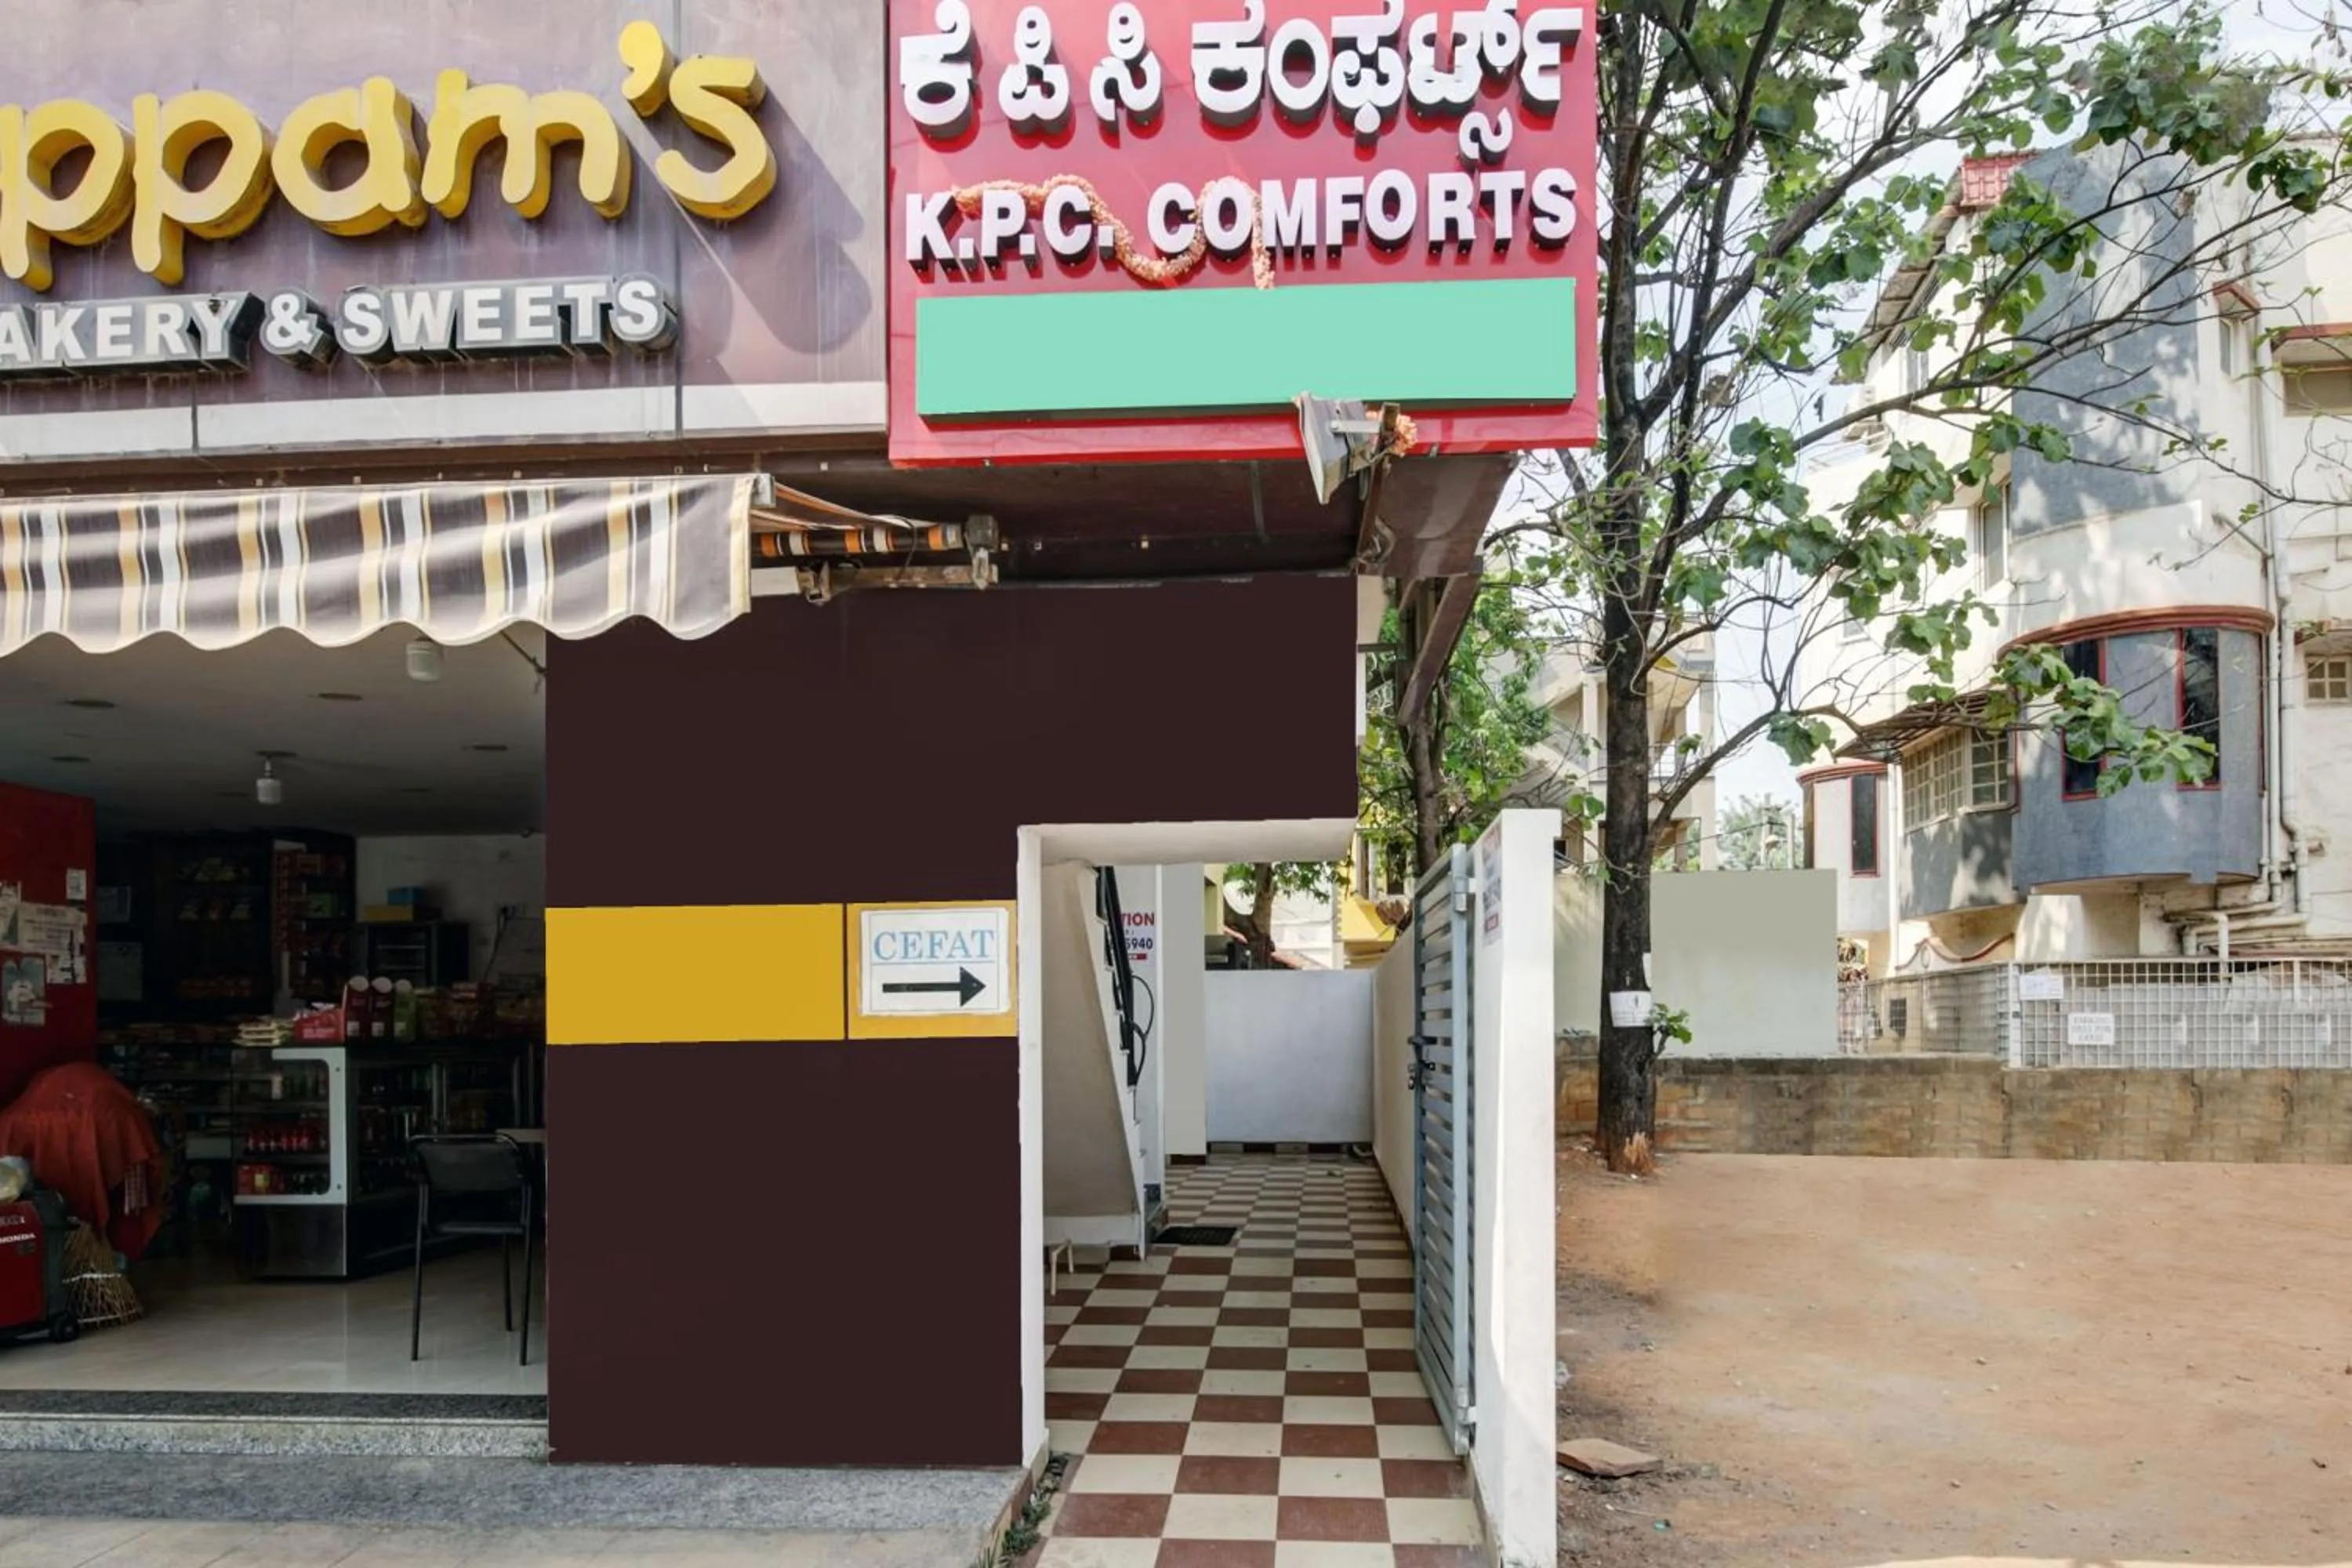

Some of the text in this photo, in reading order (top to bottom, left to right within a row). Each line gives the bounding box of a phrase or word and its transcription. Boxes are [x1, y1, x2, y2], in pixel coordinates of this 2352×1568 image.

[998, 5, 1070, 122] ಪಿ
[1089, 2, 1161, 122] ಸಿ
[905, 168, 1578, 262] K.P.C. COMFORTS
[264, 292, 318, 350] &
[343, 280, 661, 354] SWEETS
[873, 929, 995, 961] CEFAT
